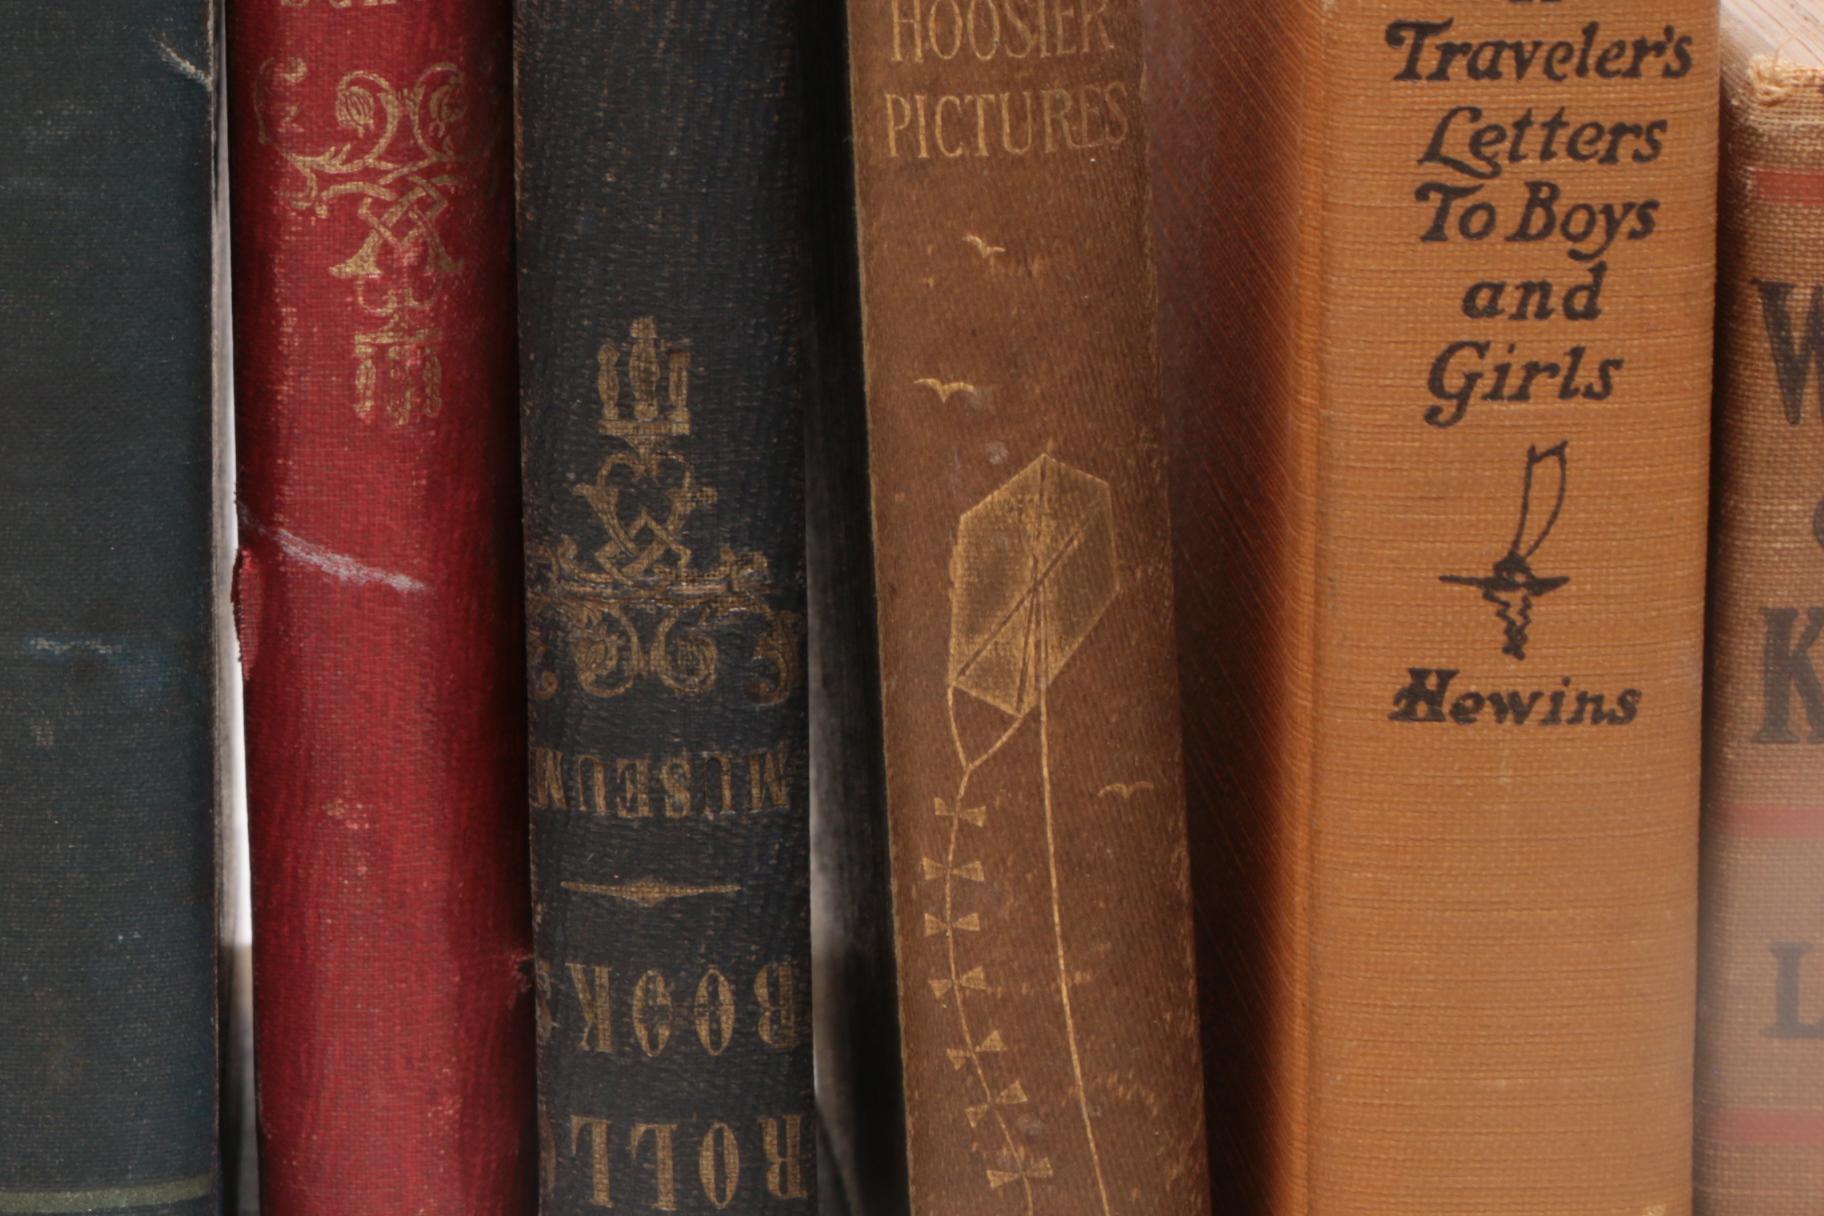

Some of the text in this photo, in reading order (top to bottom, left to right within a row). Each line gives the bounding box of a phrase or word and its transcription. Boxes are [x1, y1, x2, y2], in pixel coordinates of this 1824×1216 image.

[1384, 17, 1694, 84] Traveler's
[885, 84, 1130, 159] PICTURES
[1418, 104, 1668, 179] Letters
[1415, 180, 1660, 259] To Boys
[1461, 261, 1610, 321] and
[1424, 340, 1624, 427] Girls
[1388, 668, 1642, 726] Hewins
[531, 746, 792, 818] MUSEUM
